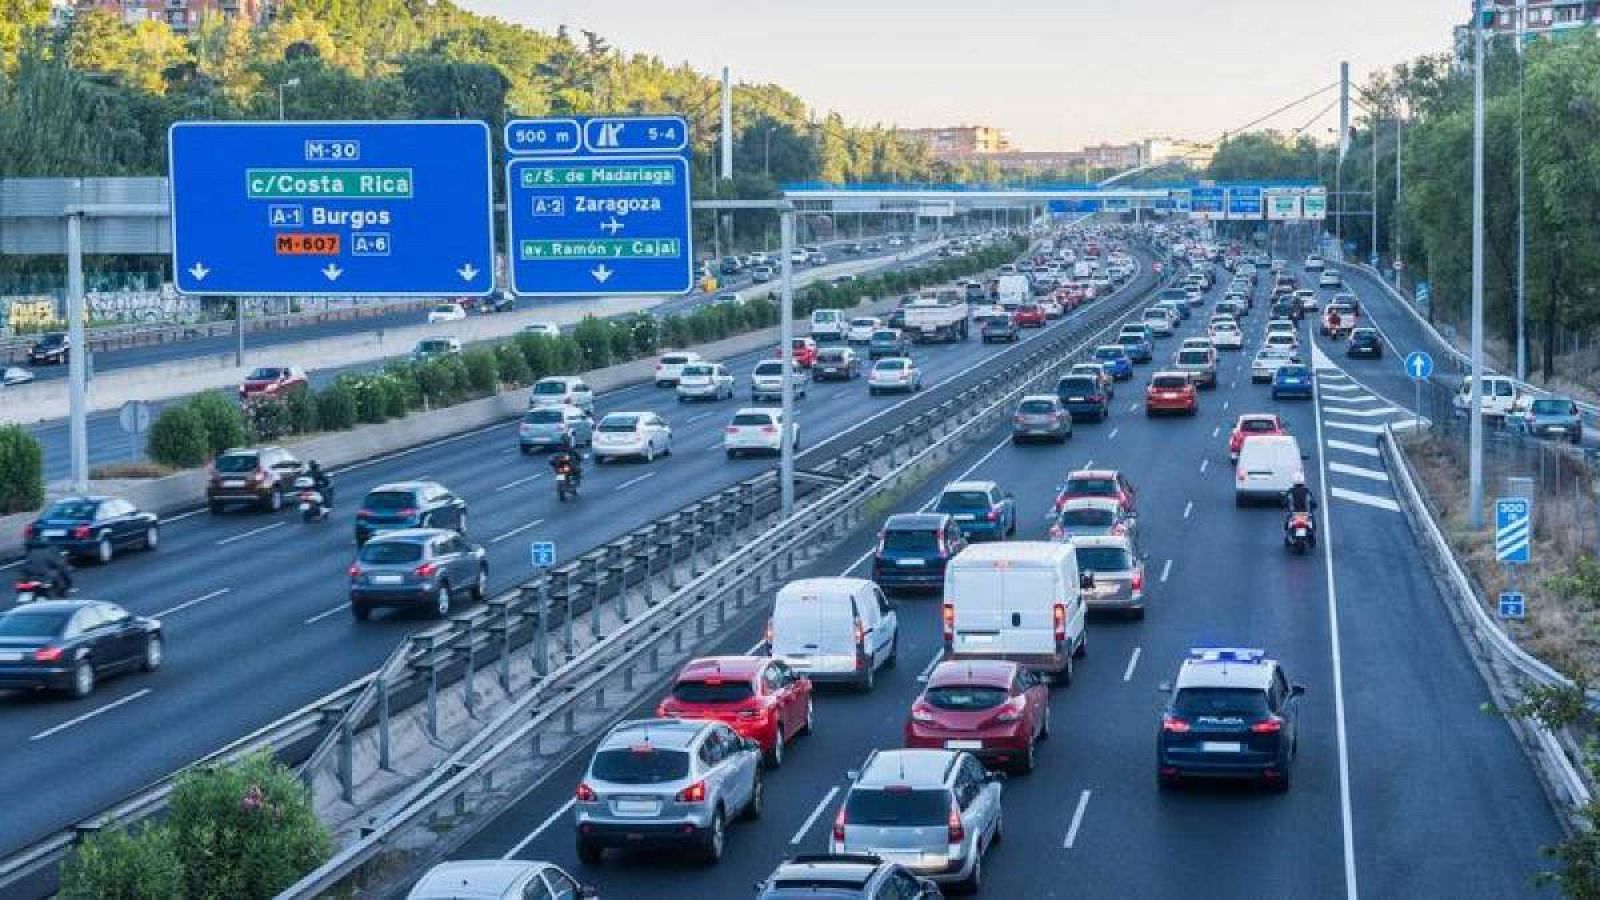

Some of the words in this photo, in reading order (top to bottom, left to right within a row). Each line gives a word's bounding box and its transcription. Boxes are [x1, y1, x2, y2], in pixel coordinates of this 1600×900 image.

[515, 130, 547, 143] 500
[555, 132, 569, 143] m
[308, 143, 357, 158] M-30
[251, 174, 345, 194] c/Costa
[359, 174, 410, 193] Rica
[565, 170, 585, 182] de
[591, 168, 673, 185] Madariaga
[534, 199, 562, 213] A-2
[575, 195, 661, 216] Zaragoza
[272, 207, 300, 224] A-1
[311, 207, 391, 229] Burgos
[277, 237, 338, 252] M-607
[354, 235, 386, 252] A-6
[524, 245, 547, 256] av.
[552, 241, 607, 255] Ramón
[614, 244, 623, 257] y
[631, 241, 675, 257] Cajal
